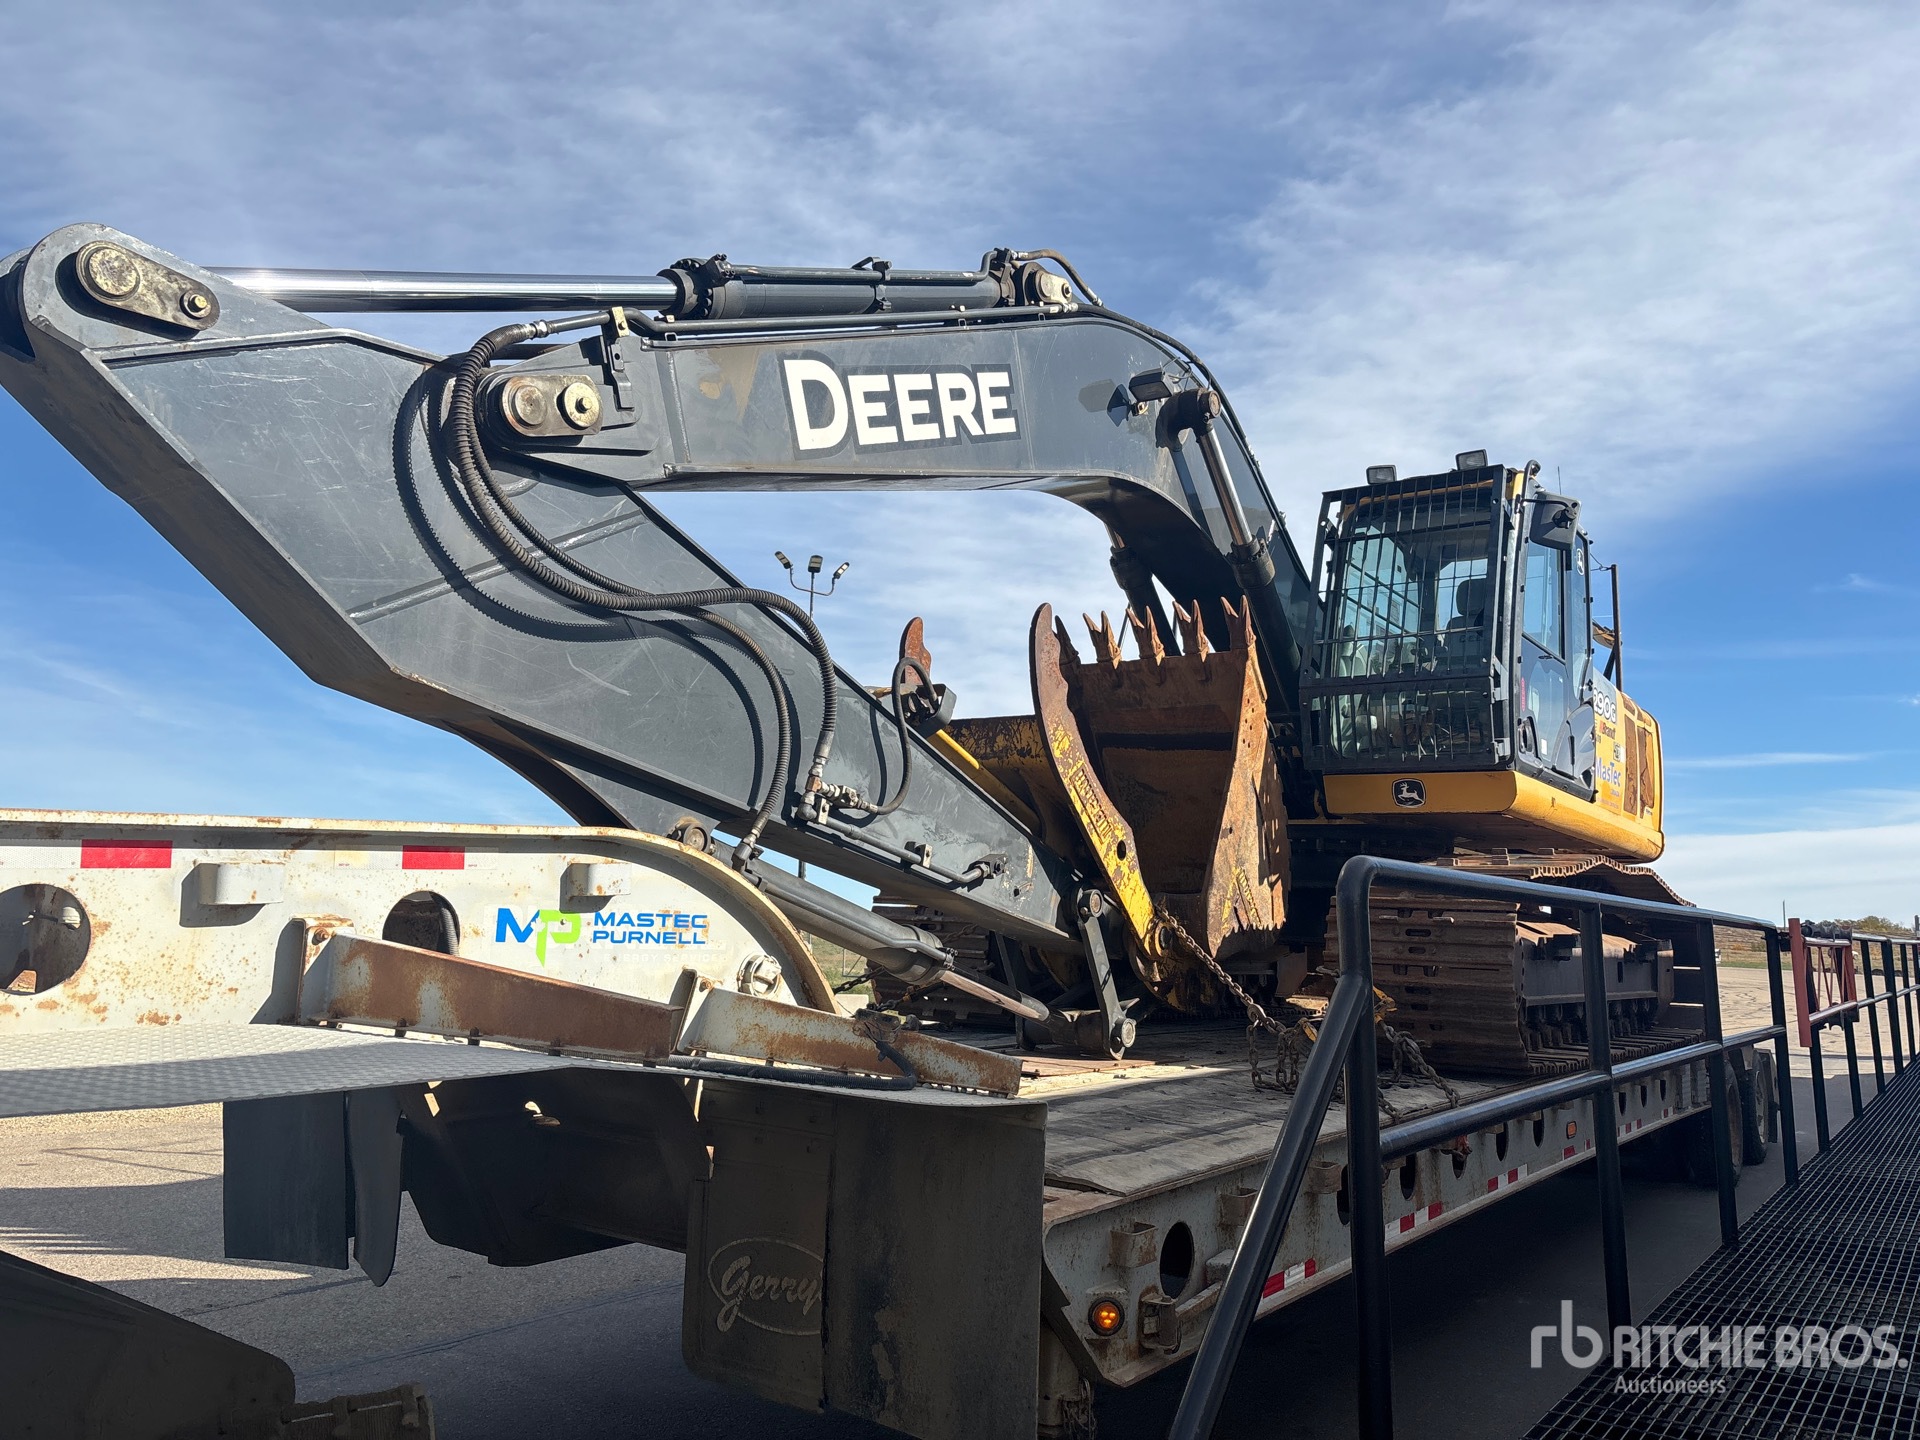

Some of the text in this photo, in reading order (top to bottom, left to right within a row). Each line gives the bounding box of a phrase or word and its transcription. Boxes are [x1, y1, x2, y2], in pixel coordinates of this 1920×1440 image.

[783, 359, 1017, 450] DEERE
[592, 930, 706, 945] PURNELL
[593, 911, 708, 929] MASTEC
[717, 1255, 822, 1332] Gerry
